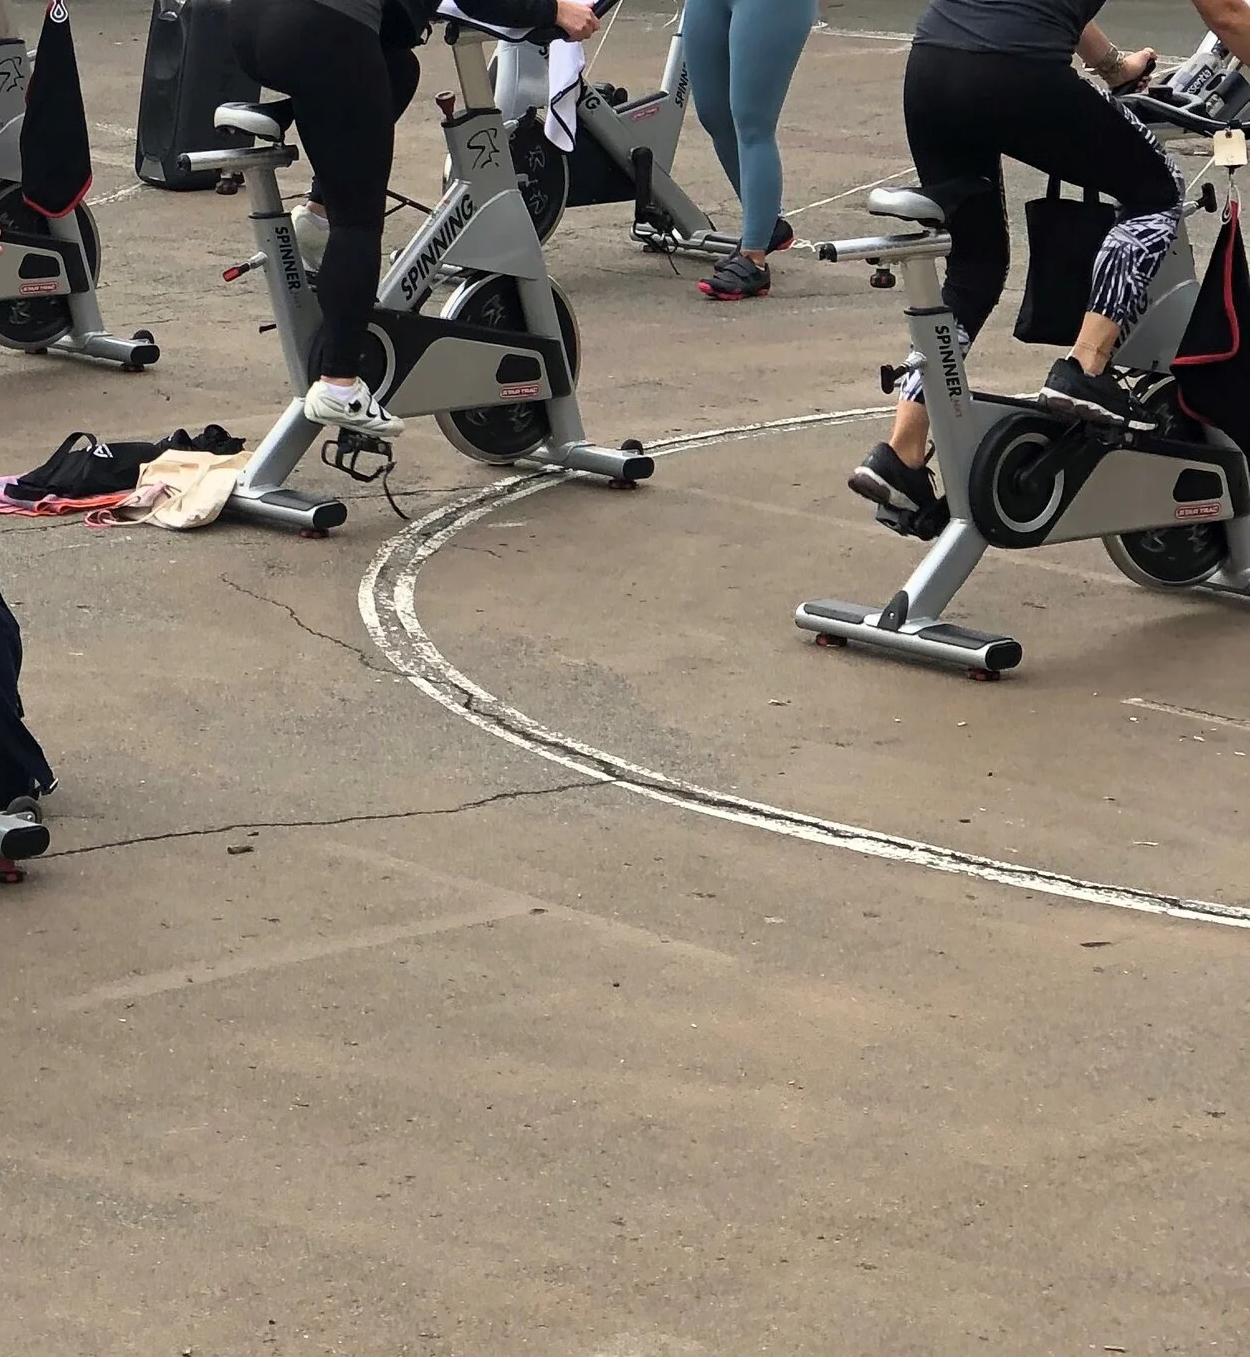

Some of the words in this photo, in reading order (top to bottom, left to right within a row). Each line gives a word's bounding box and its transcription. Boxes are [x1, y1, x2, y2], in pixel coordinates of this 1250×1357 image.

[675, 62, 689, 108] SPINN
[1187, 69, 1212, 95] ssentia
[275, 227, 301, 290] SPINNER
[401, 194, 474, 301] SPINNING
[935, 325, 962, 398] SPINNER
